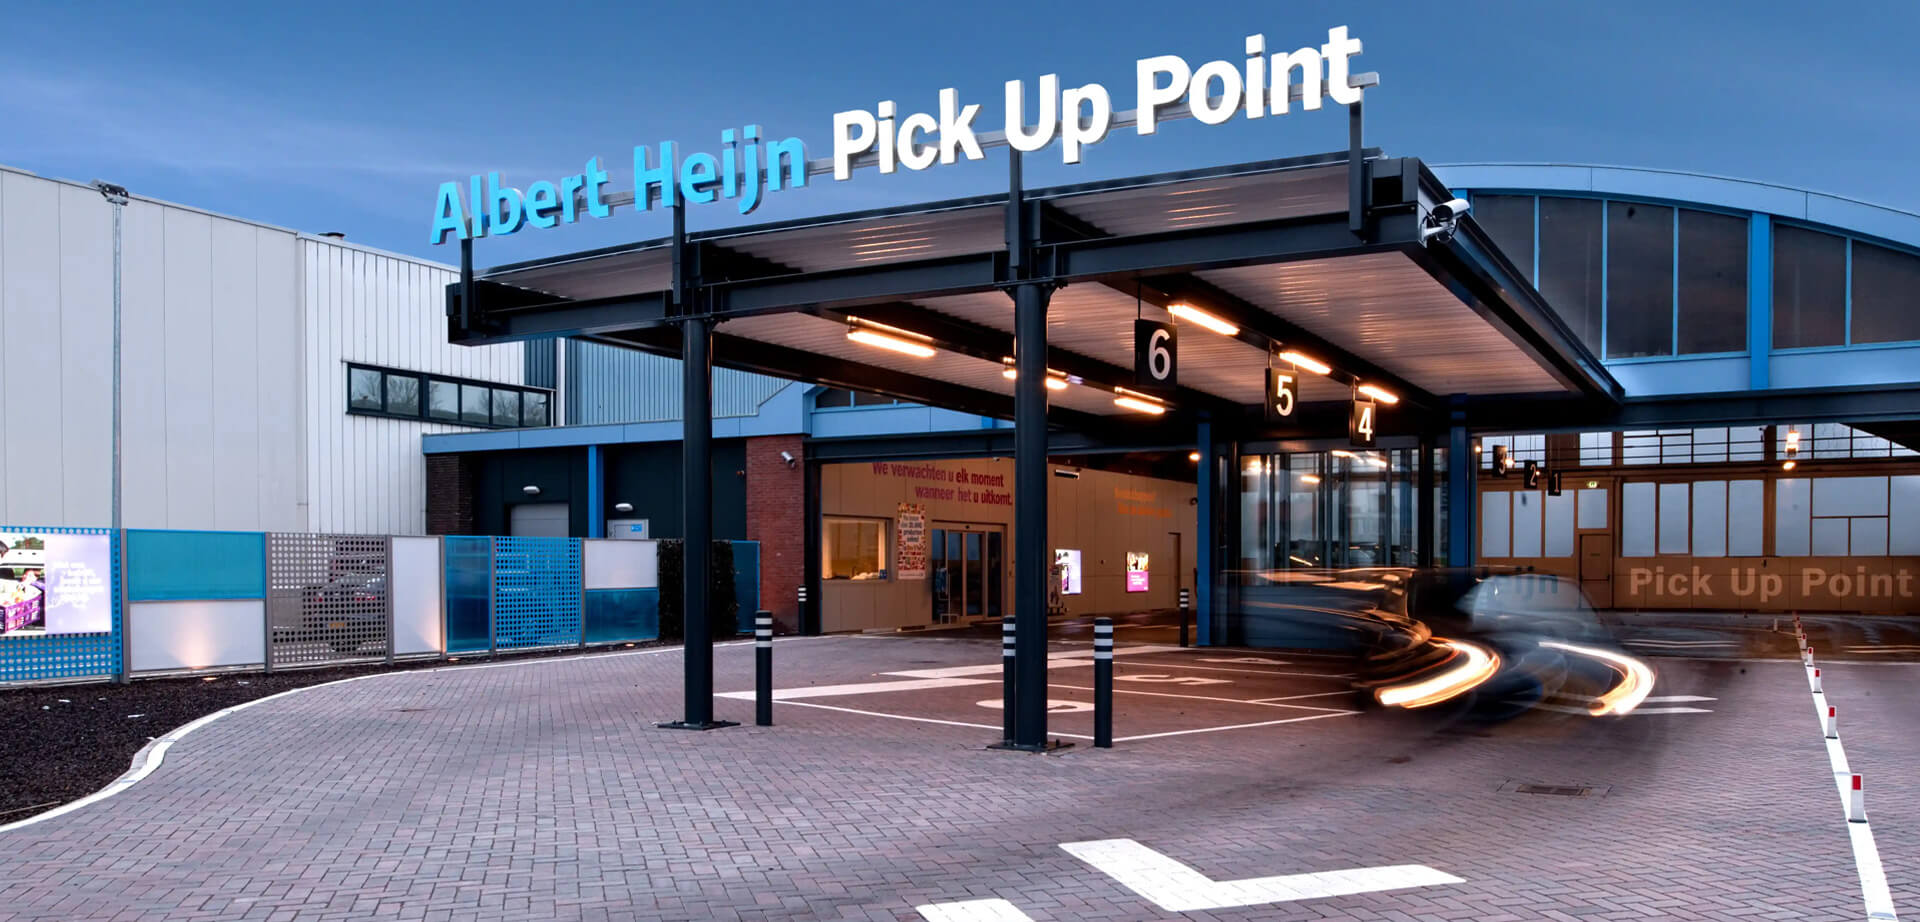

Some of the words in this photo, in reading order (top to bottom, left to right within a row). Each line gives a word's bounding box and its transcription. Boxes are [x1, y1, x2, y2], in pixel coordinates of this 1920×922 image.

[431, 156, 610, 245] Albert
[634, 124, 808, 215] Heijn
[833, 87, 985, 181] Pick
[1005, 73, 1111, 164] Up
[1137, 25, 1361, 135] Point
[1148, 329, 1171, 380] 6
[1276, 375, 1294, 417] 5
[1358, 407, 1373, 441] 4
[872, 462, 888, 475] We
[891, 464, 946, 481] verwachten
[948, 471, 955, 482] u
[956, 468, 969, 484] elk
[971, 473, 1004, 487] moment
[1529, 463, 1537, 486] 2
[1553, 472, 1560, 493] 1
[915, 486, 954, 500] wanneer
[958, 487, 971, 502] het
[973, 491, 979, 503] u
[1629, 566, 1713, 596] Pick
[1730, 567, 1783, 603] Up
[1801, 566, 1913, 597] Point
